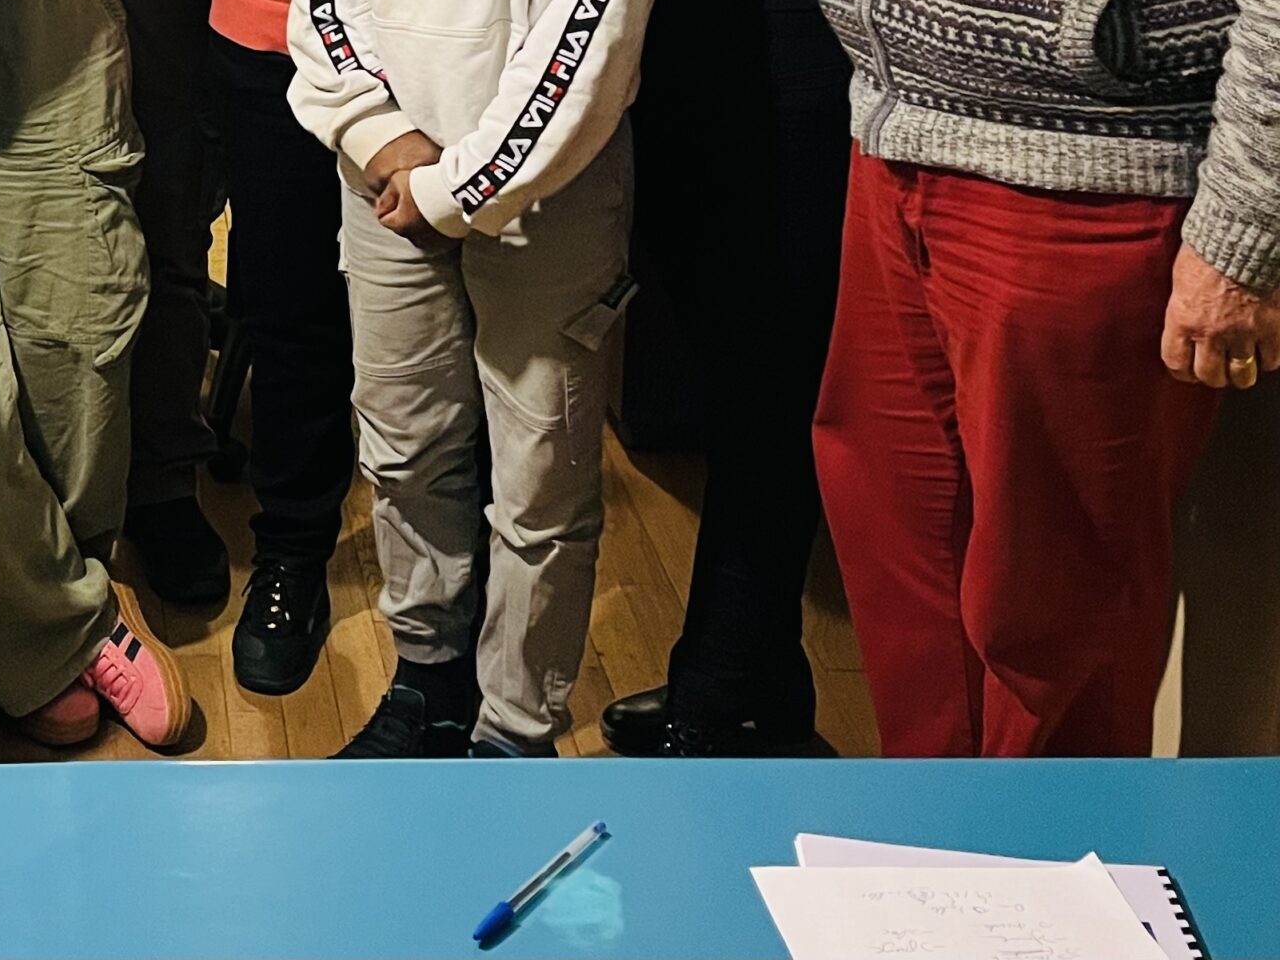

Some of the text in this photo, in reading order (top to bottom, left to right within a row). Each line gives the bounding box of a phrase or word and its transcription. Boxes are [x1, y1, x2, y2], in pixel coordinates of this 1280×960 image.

[550, 30, 590, 81] FILA
[520, 80, 564, 129] FILA
[489, 138, 533, 181] FILA
[455, 174, 495, 207] FIL
